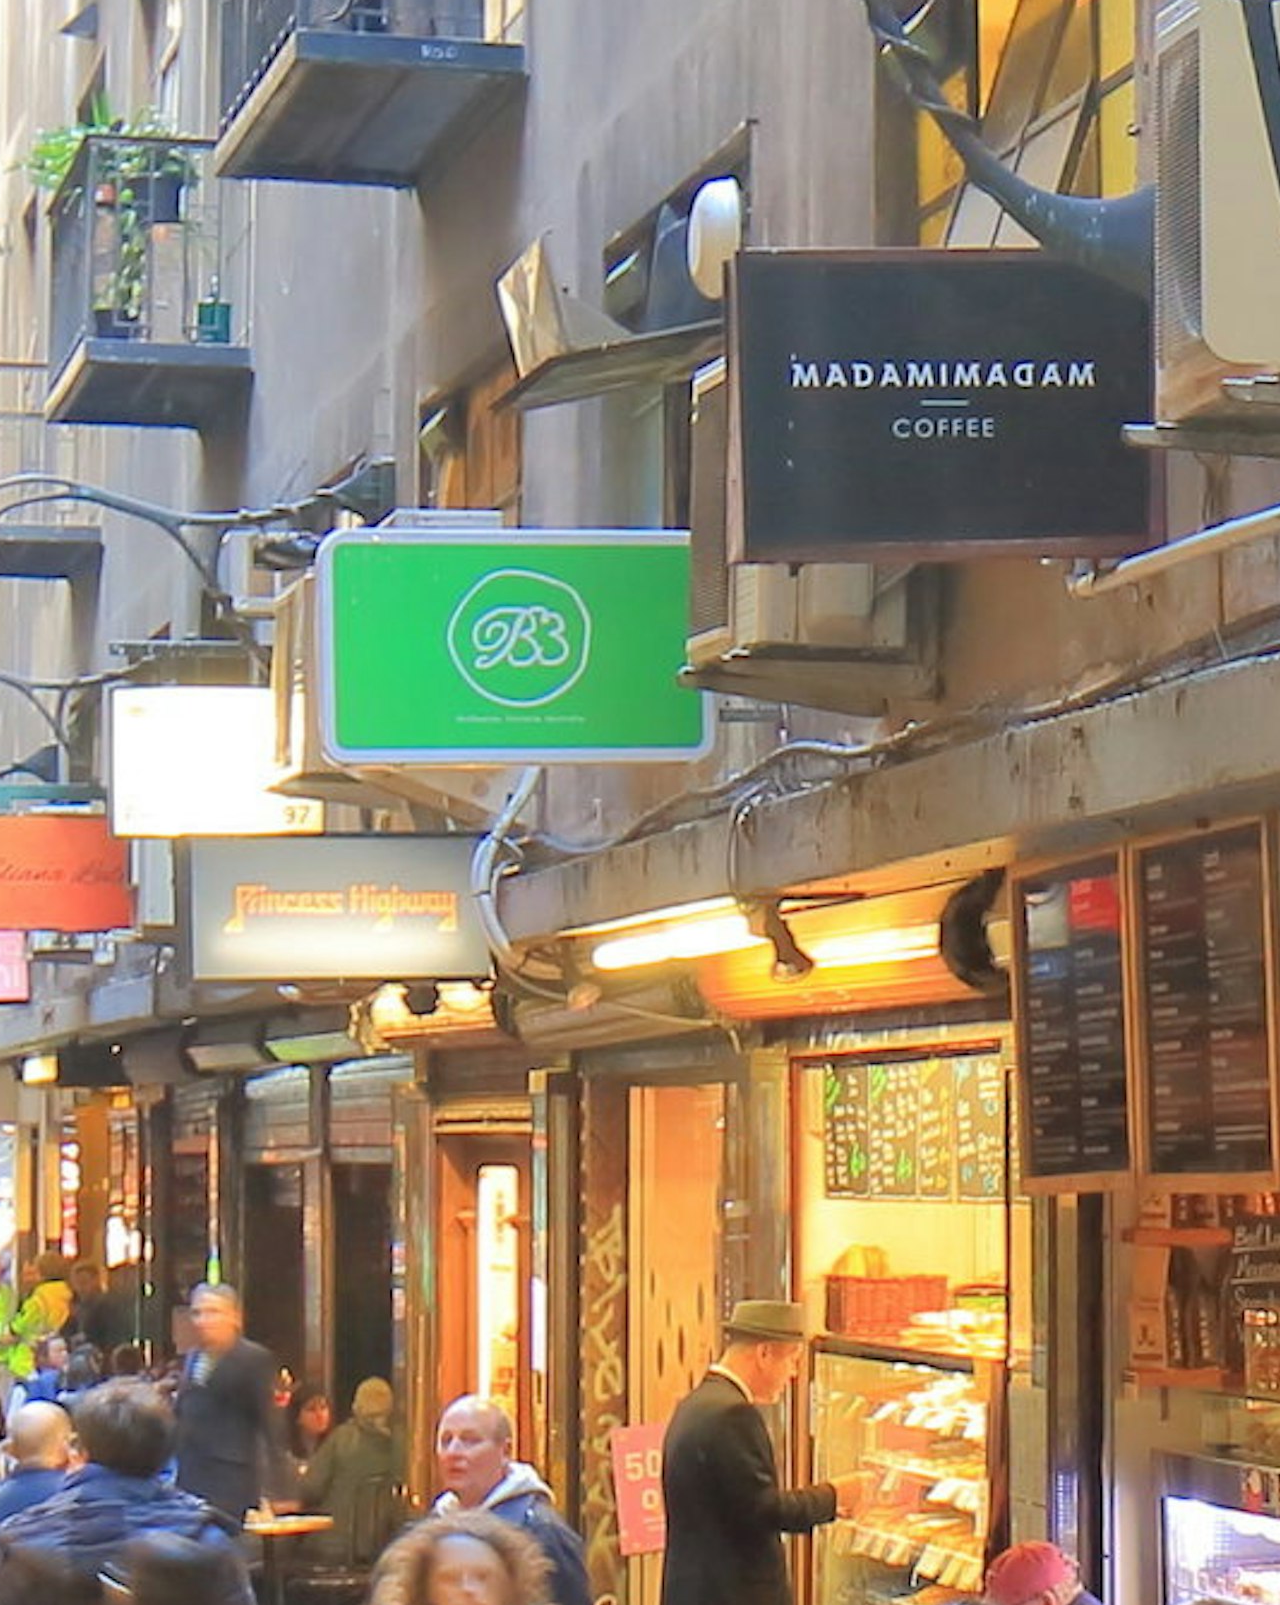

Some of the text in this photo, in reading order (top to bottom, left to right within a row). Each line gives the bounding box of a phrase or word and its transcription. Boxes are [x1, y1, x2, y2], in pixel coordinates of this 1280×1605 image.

[892, 418, 995, 438] COFFEE
[283, 806, 311, 824] 97
[225, 884, 458, 932] Princess Highway
